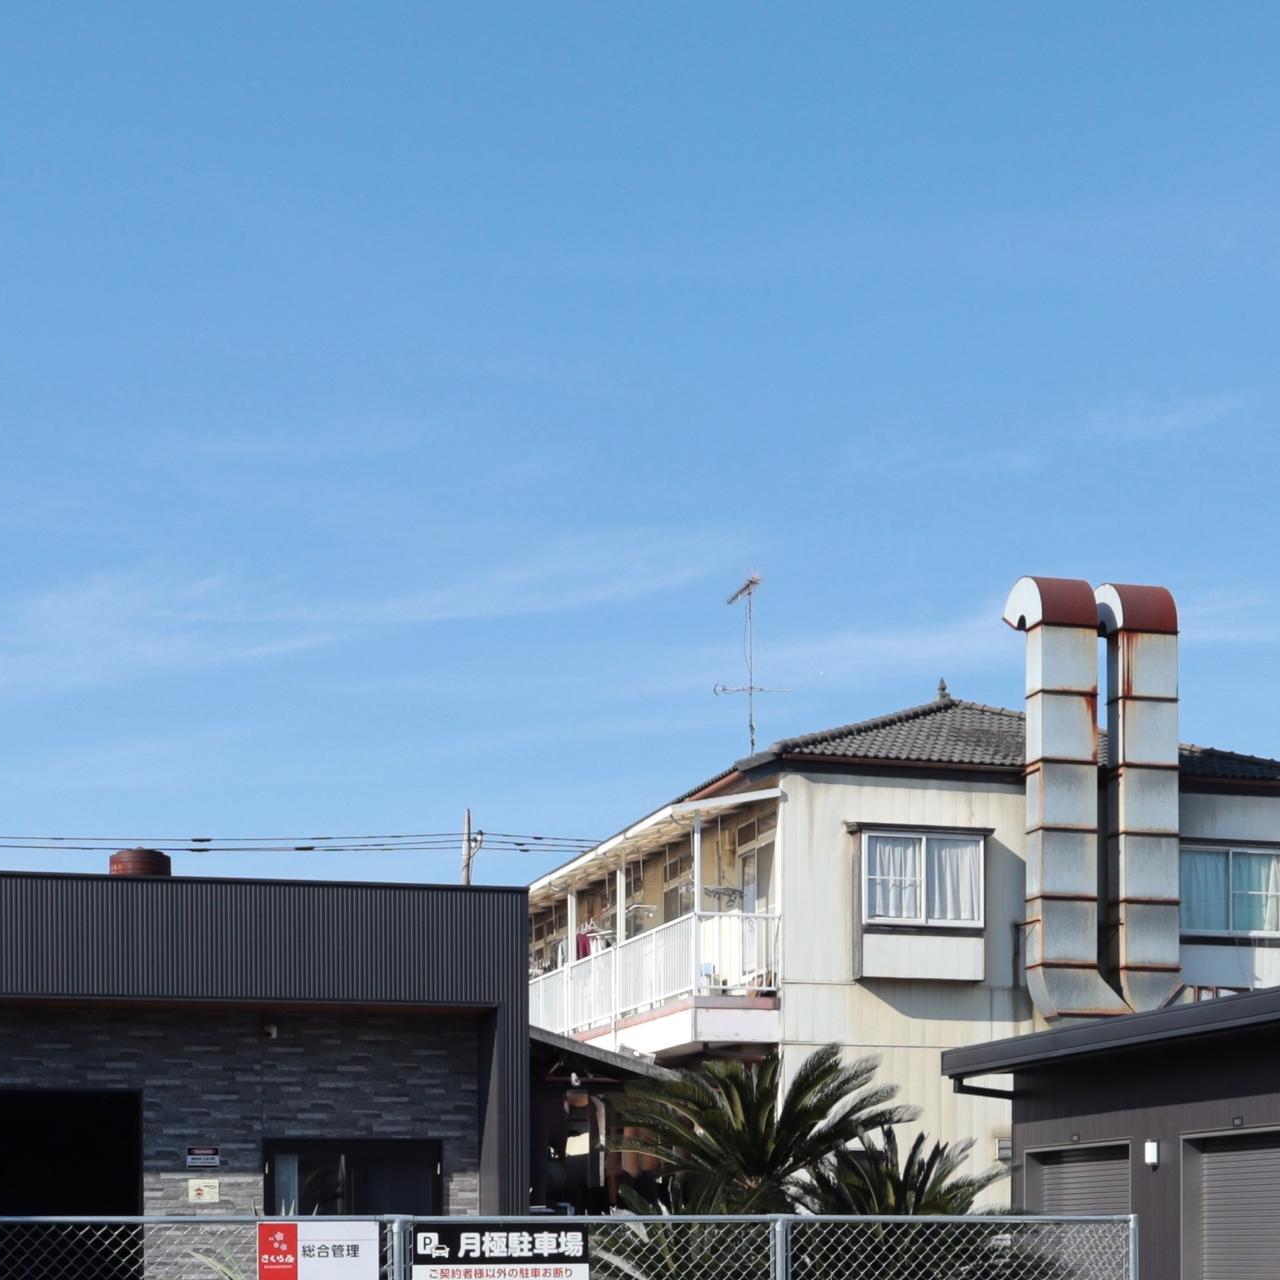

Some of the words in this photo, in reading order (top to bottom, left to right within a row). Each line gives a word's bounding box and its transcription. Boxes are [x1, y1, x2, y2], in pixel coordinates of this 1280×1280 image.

[301, 1244, 360, 1258] 総合管理
[458, 1231, 584, 1258] 月極駐車場
[429, 1267, 573, 1280] ご契約者様以外の駐車お断り
